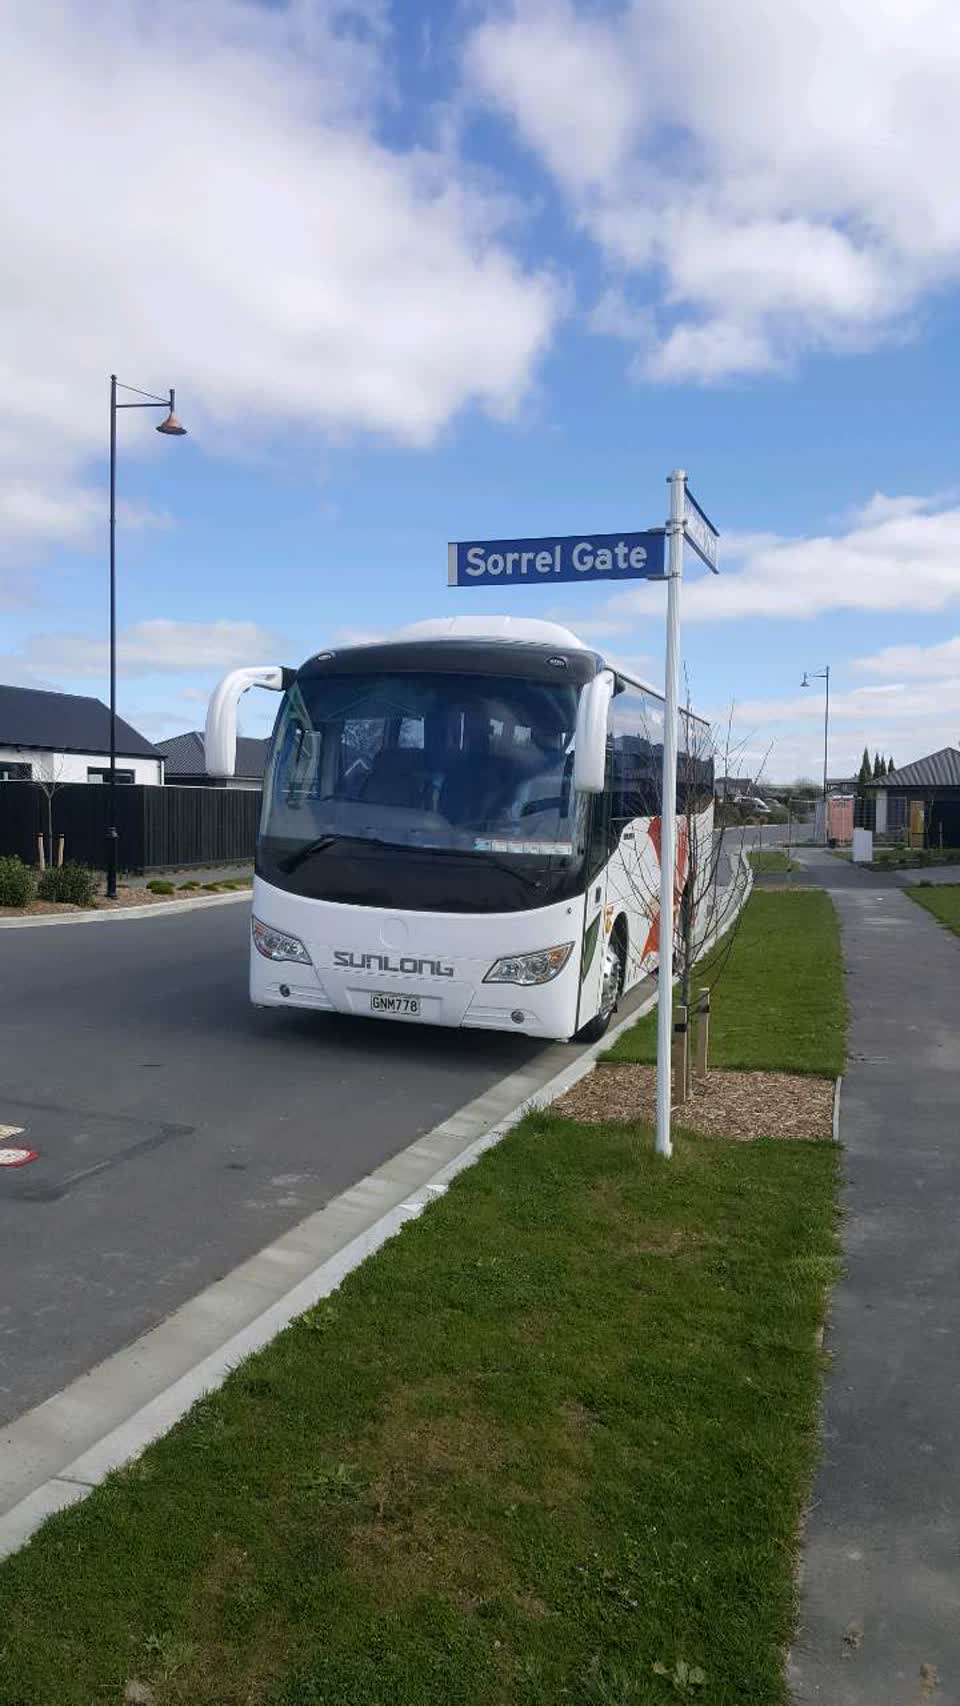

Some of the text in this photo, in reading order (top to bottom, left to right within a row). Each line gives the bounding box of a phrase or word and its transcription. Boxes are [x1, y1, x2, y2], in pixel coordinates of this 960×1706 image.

[465, 542, 648, 577] Sorrel Gate
[333, 951, 454, 977] SUNLONG
[372, 996, 418, 1012] GNM778
